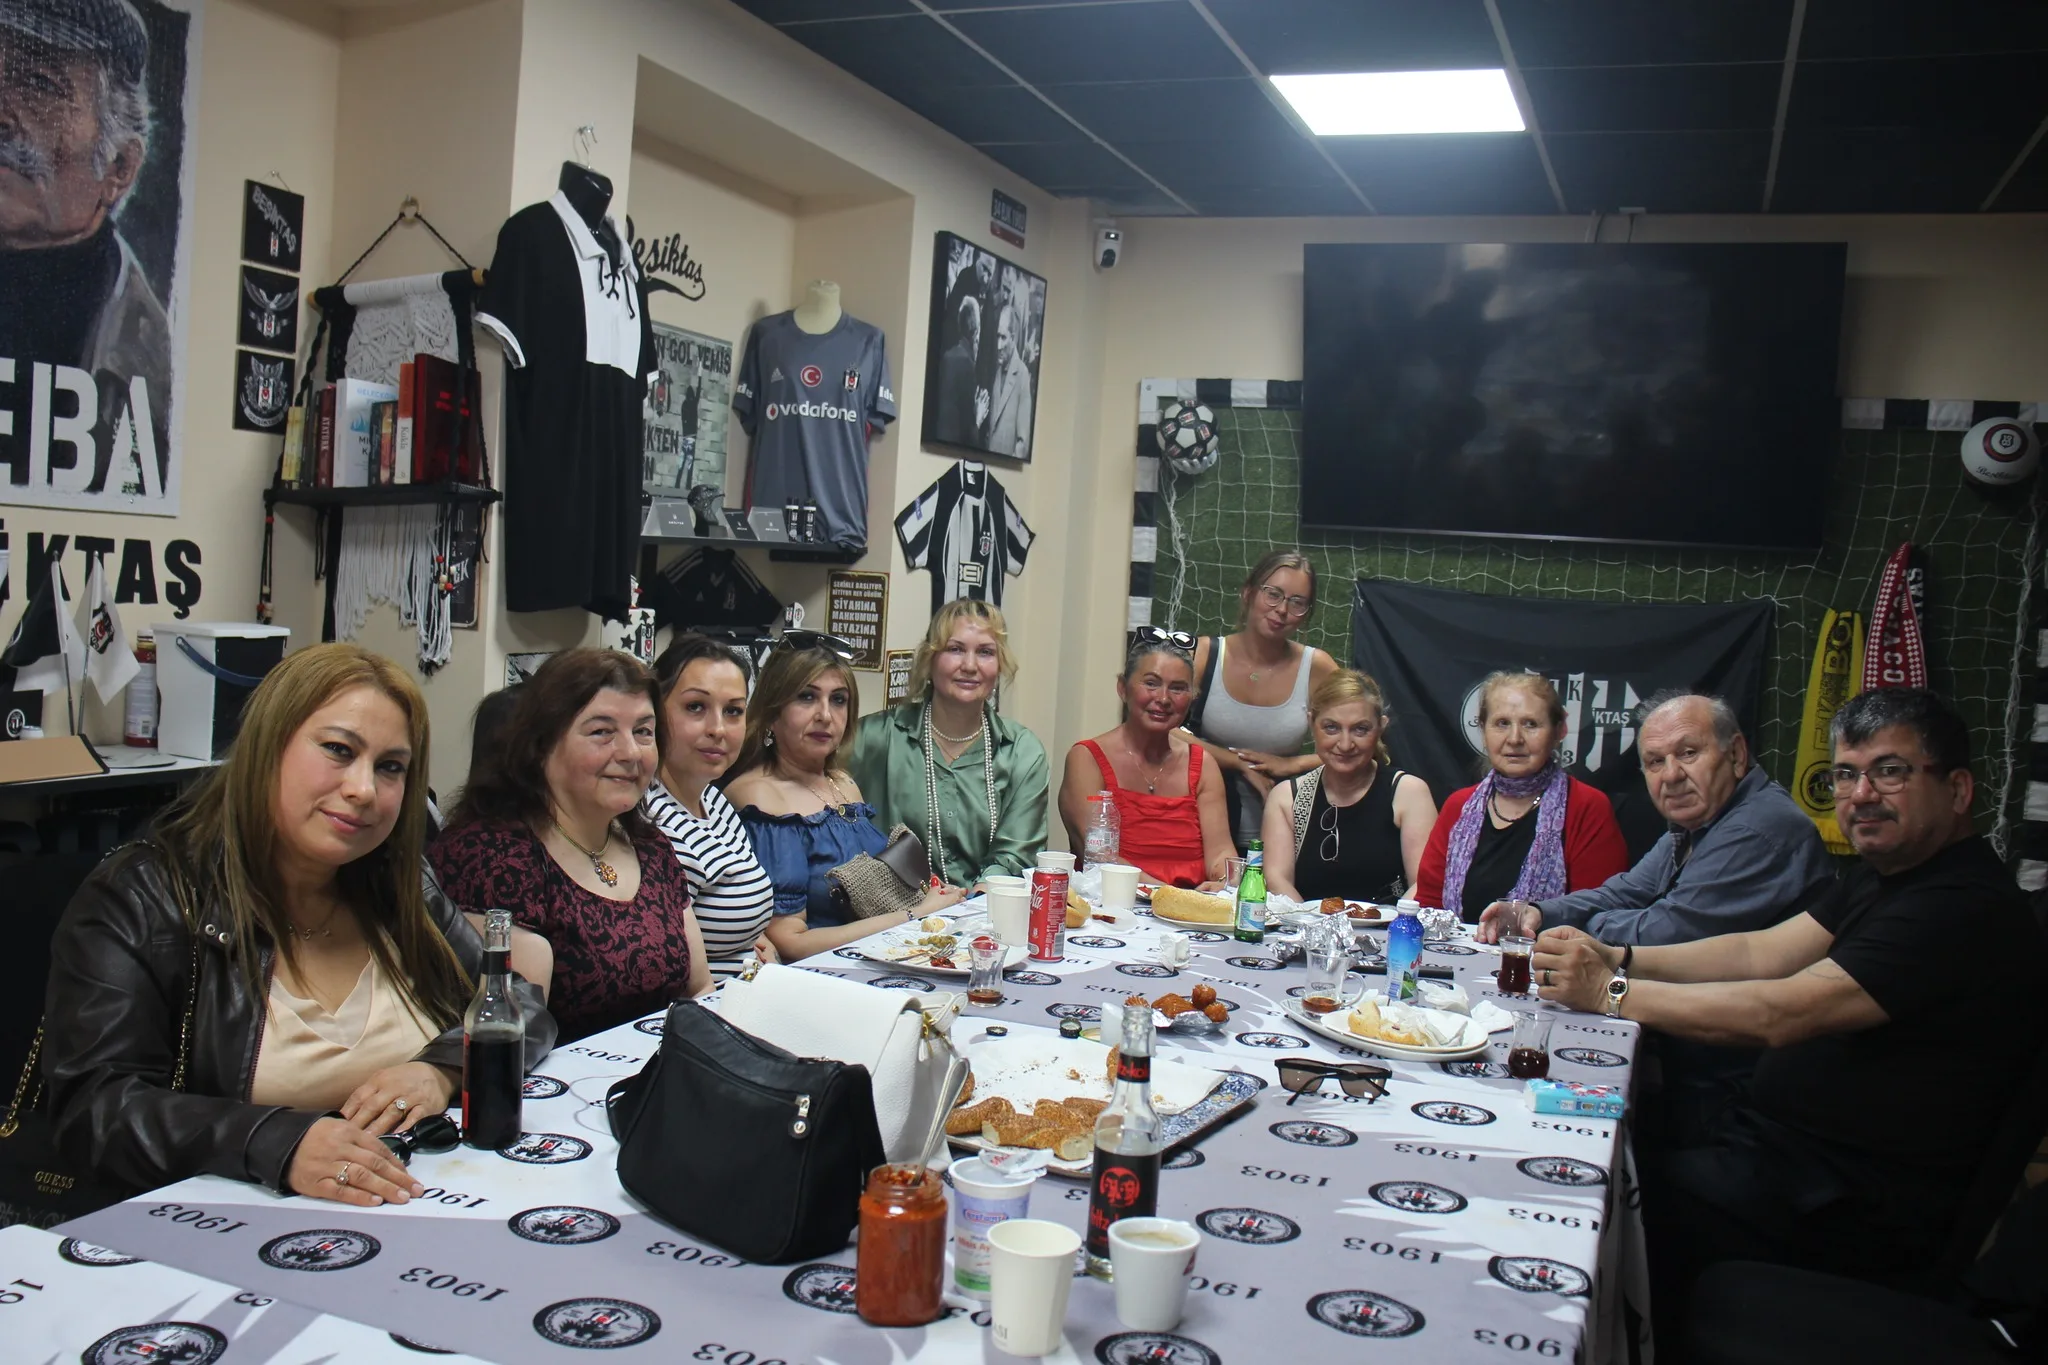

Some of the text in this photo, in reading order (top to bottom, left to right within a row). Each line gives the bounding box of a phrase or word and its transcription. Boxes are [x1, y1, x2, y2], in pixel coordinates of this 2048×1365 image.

[779, 401, 857, 423] vodafone
[834, 597, 876, 612] SİYAHINA
[832, 622, 876, 635] BEYAZINA
[1083, 985, 1148, 997] 1903
[1564, 1024, 1628, 1038] 1903
[569, 1046, 643, 1064] 1903
[1531, 1121, 1611, 1139] 1903
[1394, 1143, 1480, 1162] 1903
[34, 1170, 76, 1189] GUESS
[1240, 1165, 1331, 1188] 1903
[149, 1204, 249, 1234] 1903
[1508, 1207, 1600, 1233] 1903
[1343, 1237, 1443, 1265] 1903
[399, 1266, 509, 1302] 1903
